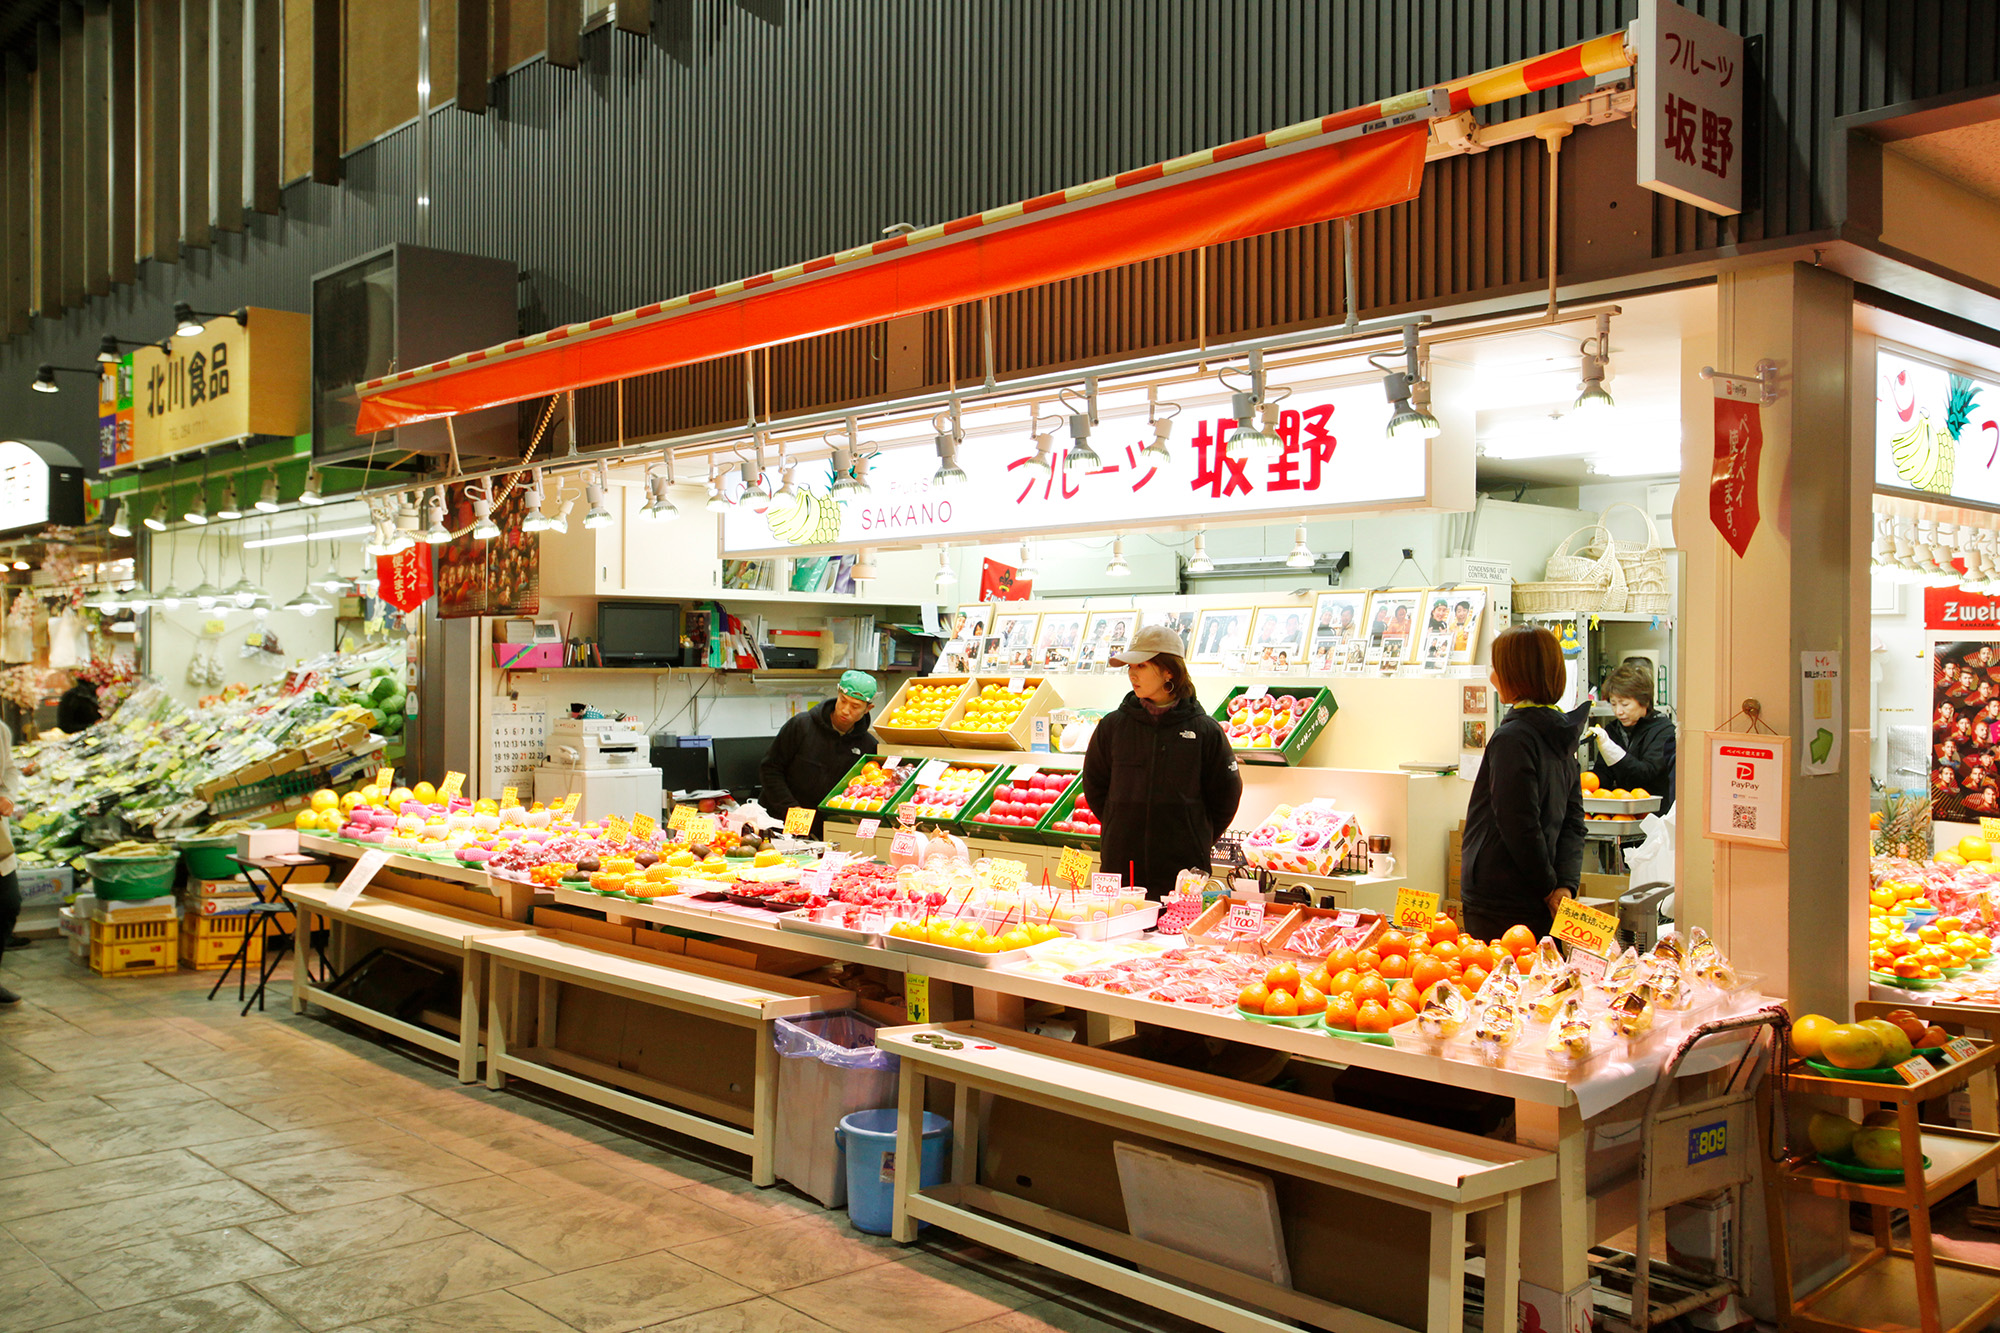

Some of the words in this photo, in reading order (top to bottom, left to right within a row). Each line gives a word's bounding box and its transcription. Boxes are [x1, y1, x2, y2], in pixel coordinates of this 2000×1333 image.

[1665, 33, 1733, 88] フルーツ
[1664, 92, 1733, 179] 坂野
[147, 342, 229, 418] 北川食品
[1190, 403, 1337, 498] 坂野
[862, 501, 952, 530] SAKANO
[405, 547, 417, 591] ペイペイ
[1468, 565, 1496, 573] CONDENSING
[1468, 571, 1488, 579] CONTROL
[1942, 601, 2000, 622] Zwei
[1815, 655, 1830, 667] トイレ
[512, 703, 517, 712] 3
[1731, 781, 1760, 791] PayPay
[1401, 908, 1432, 929] 600円
[1562, 906, 1615, 933] 高地栽培バナナ
[1561, 920, 1603, 950] 200円
[1699, 1126, 1725, 1155] 809
